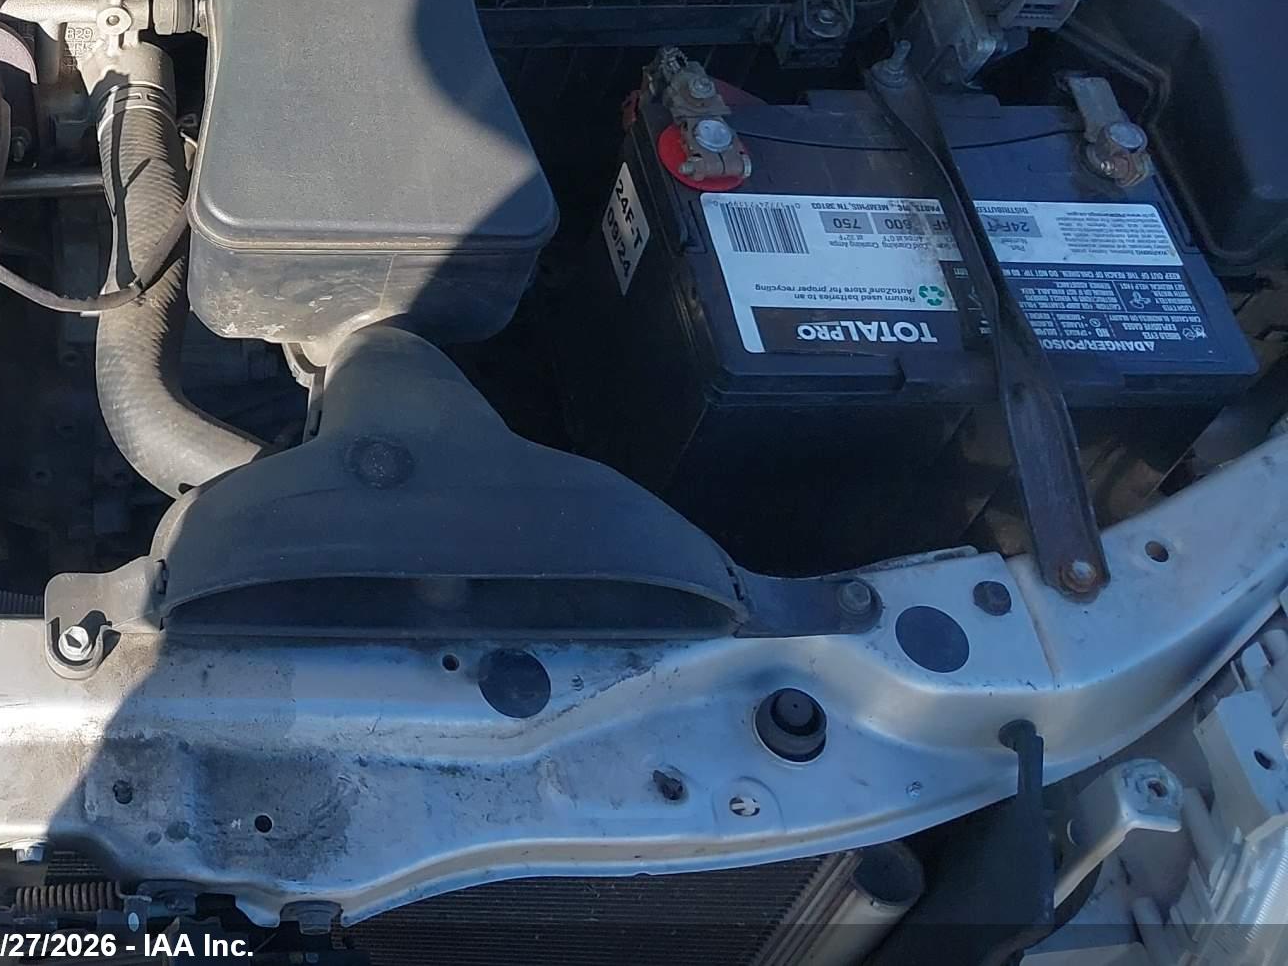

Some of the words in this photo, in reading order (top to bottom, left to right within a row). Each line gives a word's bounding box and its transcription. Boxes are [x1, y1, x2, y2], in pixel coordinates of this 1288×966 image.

[836, 202, 848, 210] TN
[849, 202, 890, 211] MEMPHIS,
[832, 218, 861, 229] 750
[607, 206, 631, 278] 09/24
[1126, 271, 1140, 279] THE
[1150, 272, 1164, 280] OUT
[1165, 272, 1181, 280] KEEP
[755, 284, 795, 292] recycling
[798, 285, 826, 293] proper
[818, 294, 859, 302] batteries
[861, 294, 882, 302] used
[885, 294, 916, 303] Return
[797, 321, 938, 343] TOTALPRO
[1095, 328, 1110, 338] NO
[1039, 339, 1146, 351] DANGER/POISO
